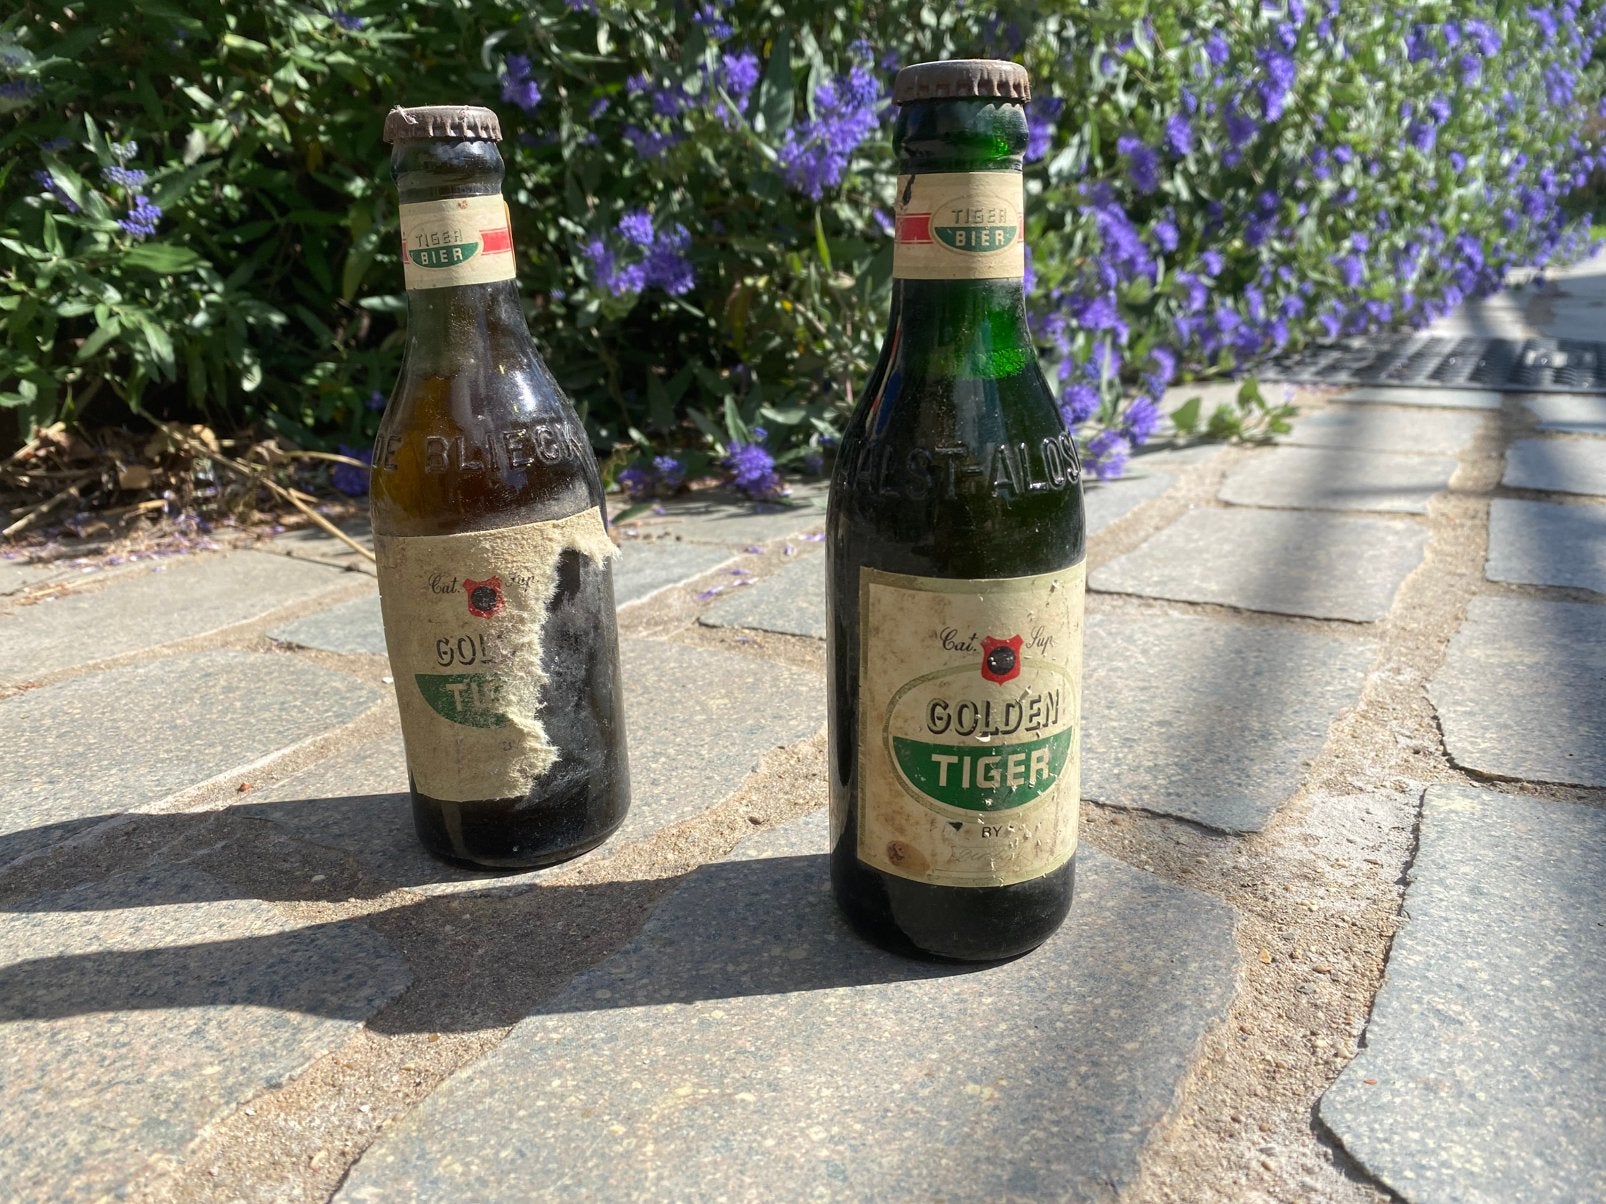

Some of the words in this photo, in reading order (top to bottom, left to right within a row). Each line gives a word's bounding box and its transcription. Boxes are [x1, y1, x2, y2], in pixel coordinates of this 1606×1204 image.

[952, 207, 1007, 225] TIGER
[415, 229, 464, 248] TIGER
[955, 229, 1005, 247] BIER
[420, 248, 464, 265] BIER
[428, 573, 461, 595] Cat.
[939, 626, 978, 652] Cat.
[926, 688, 1060, 737] GOLDEN
[931, 747, 1050, 789] TIGER
[981, 825, 1003, 839] BY
